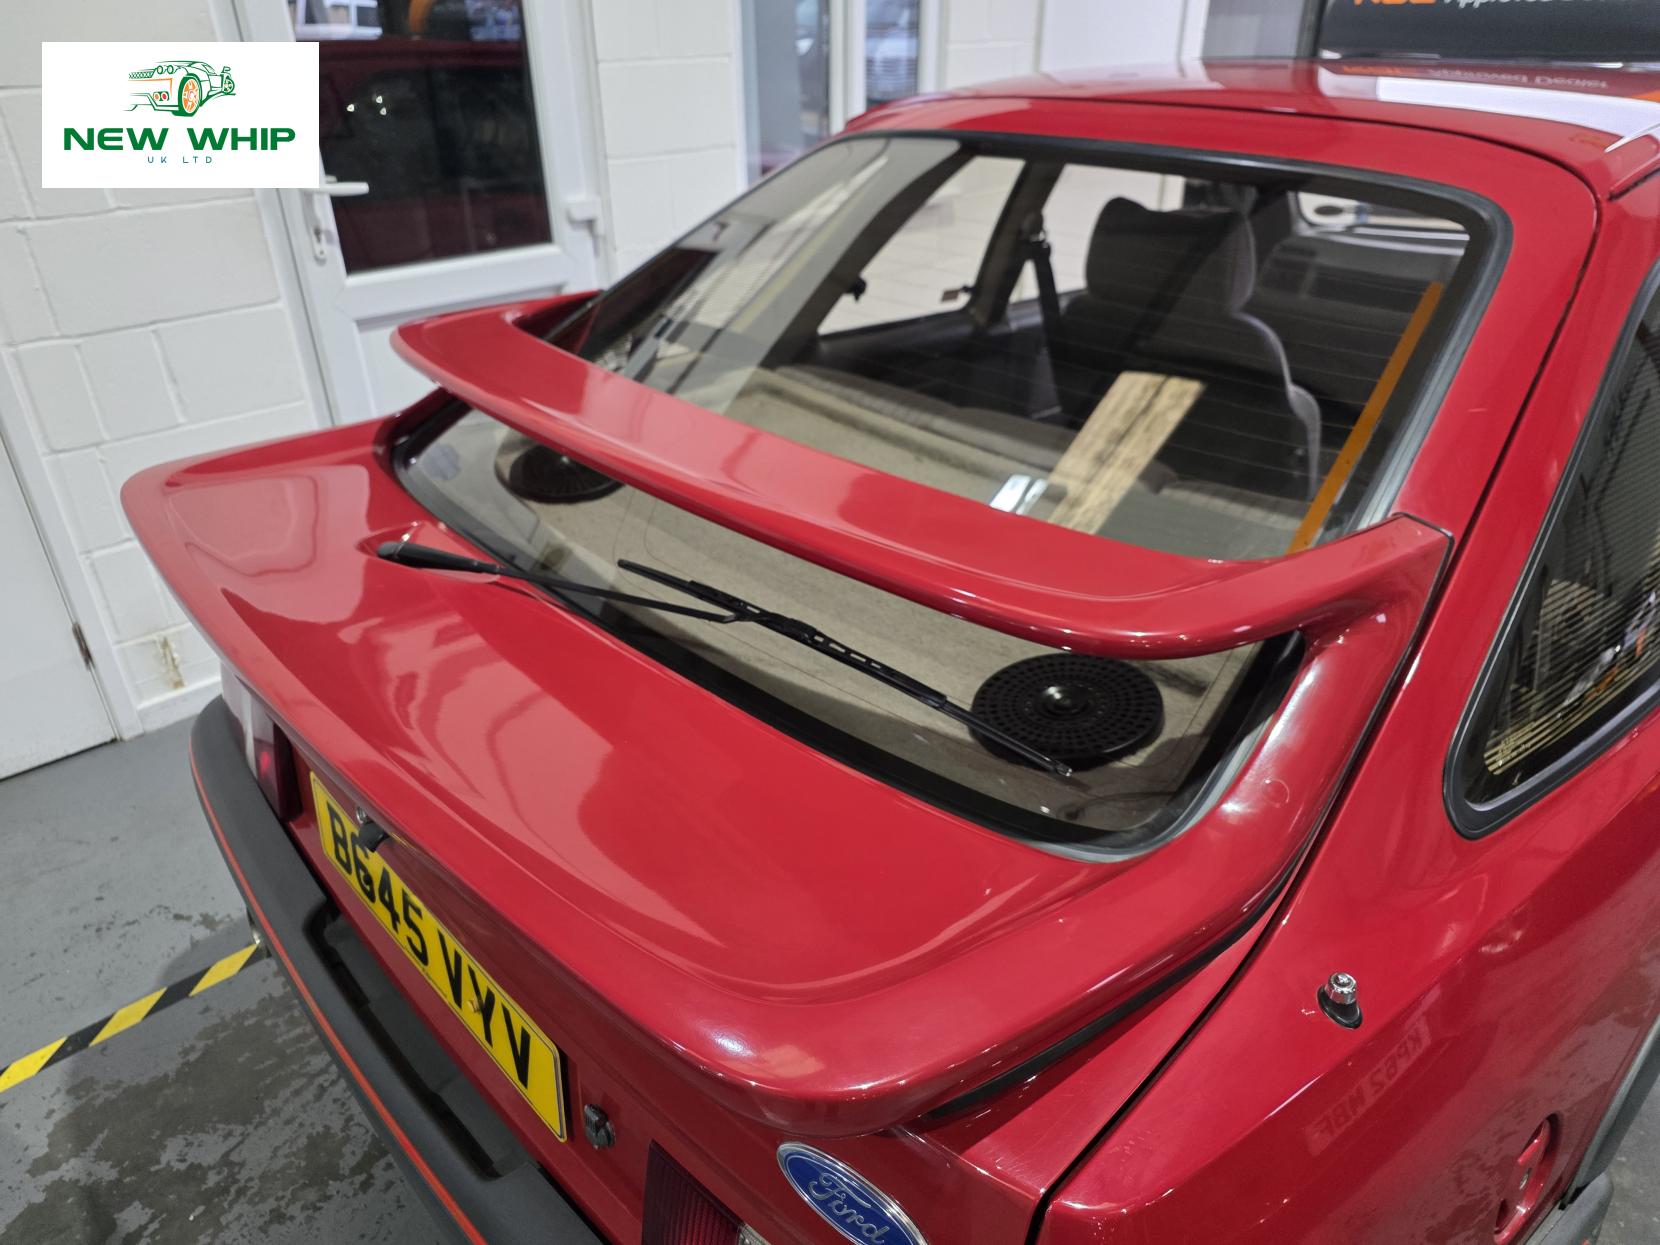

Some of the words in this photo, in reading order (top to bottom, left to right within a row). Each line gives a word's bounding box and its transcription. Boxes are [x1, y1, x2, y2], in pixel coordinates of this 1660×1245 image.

[327, 801, 428, 967] B645
[437, 928, 531, 1089] VYV
[808, 1172, 890, 1244] Ford
